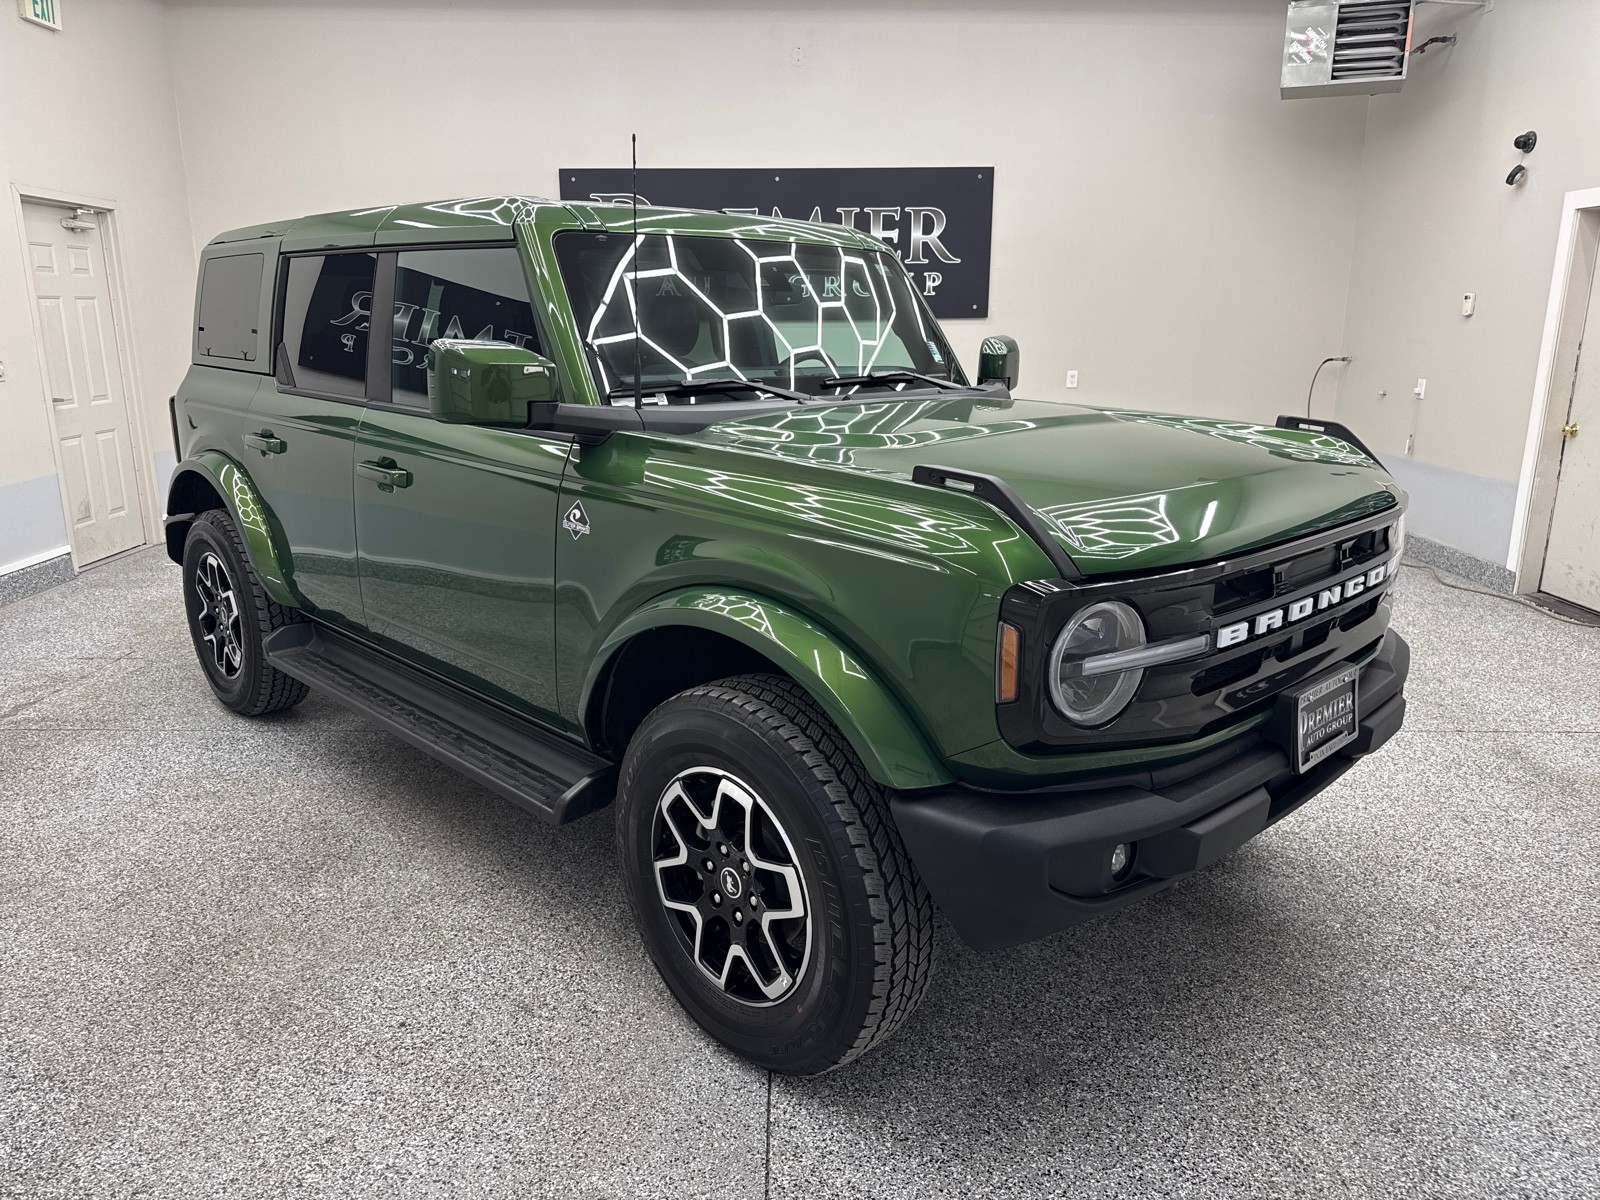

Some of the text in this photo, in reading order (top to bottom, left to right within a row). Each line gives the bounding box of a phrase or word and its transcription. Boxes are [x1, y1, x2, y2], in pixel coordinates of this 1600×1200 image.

[1217, 565, 1386, 649] BRONCO
[1300, 691, 1355, 752] PREMIER
[1306, 727, 1325, 747] AUTO
[1326, 713, 1353, 734] GROUP
